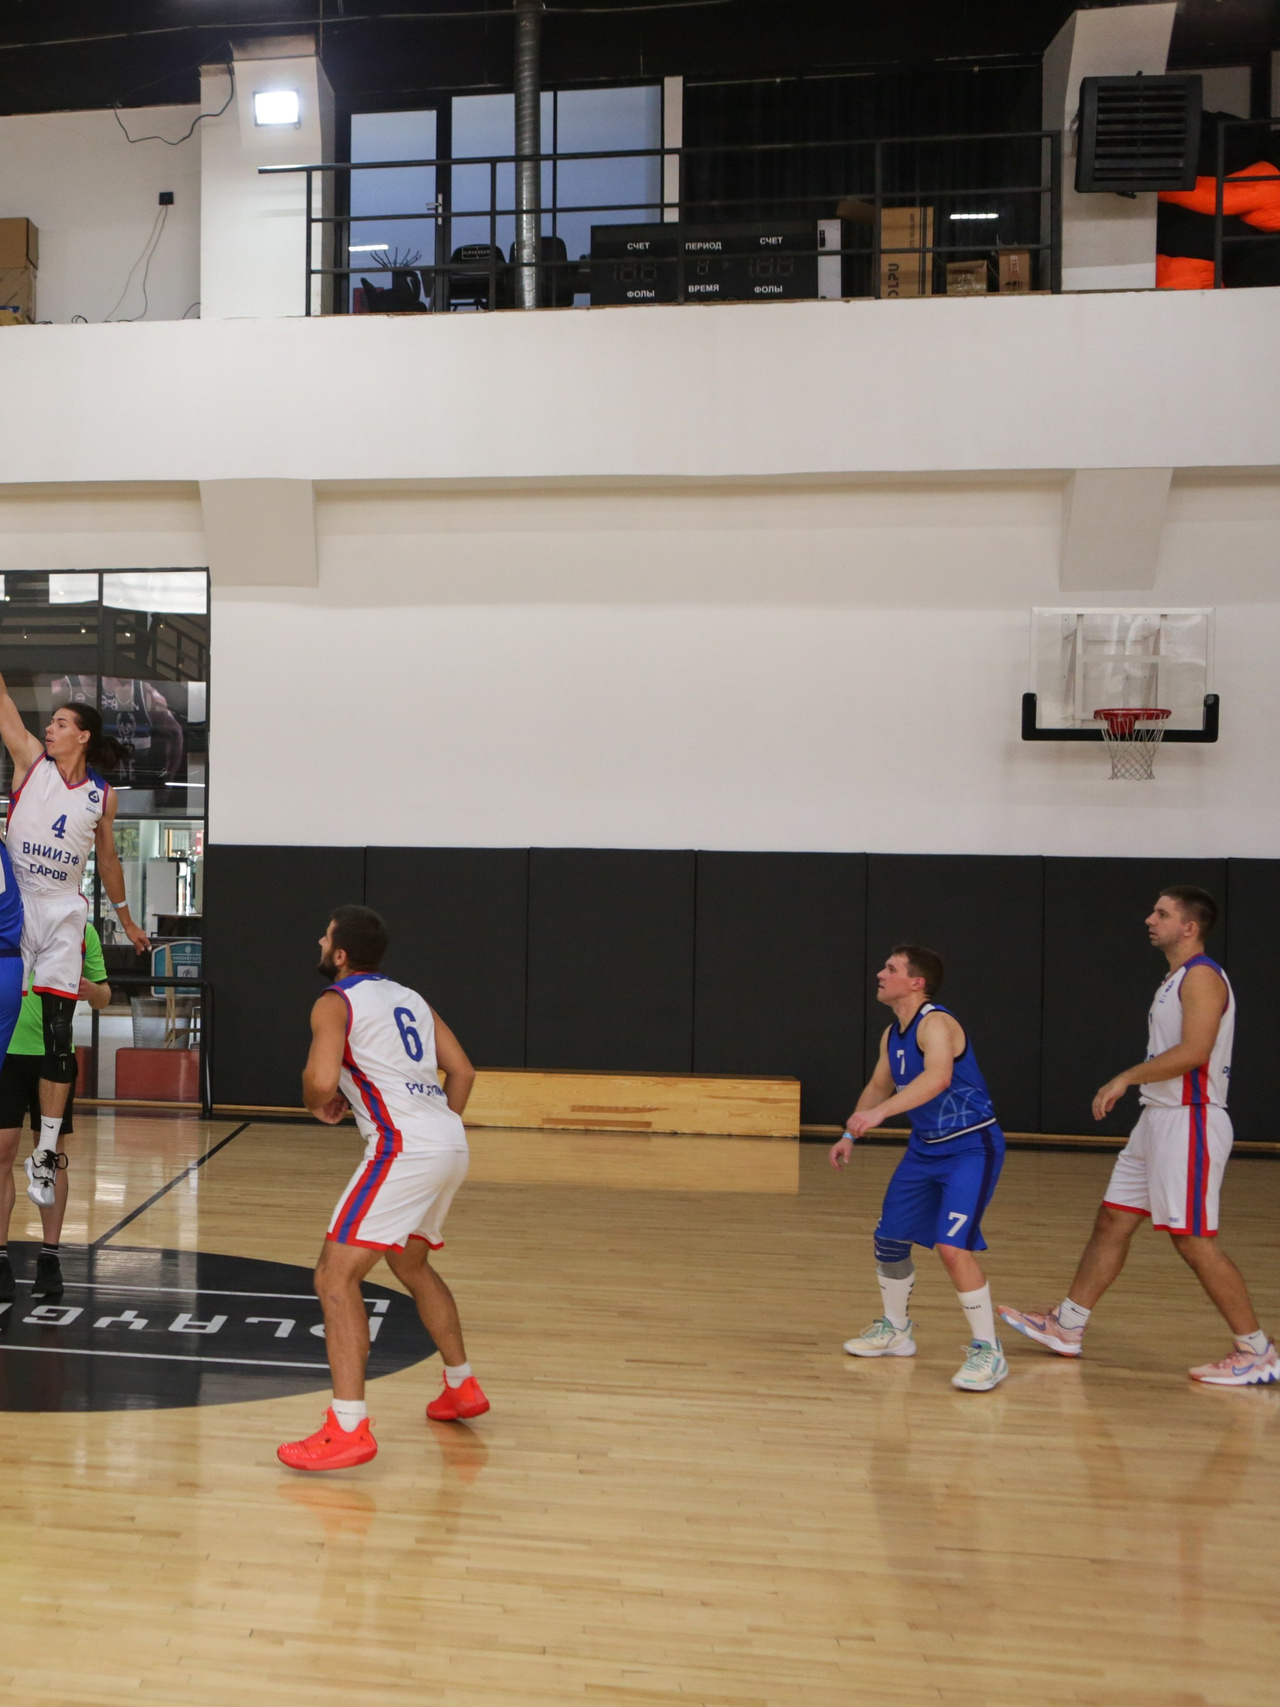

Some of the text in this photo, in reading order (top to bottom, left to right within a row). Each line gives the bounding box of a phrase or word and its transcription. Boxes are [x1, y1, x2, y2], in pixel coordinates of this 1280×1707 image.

[626, 242, 651, 250] СЧЕТ
[685, 241, 722, 250] ПЕРИОД
[759, 236, 784, 245] СЧЕТ
[626, 290, 655, 298] ФОЛЫ
[688, 284, 720, 293] ВРЕМЯ
[754, 285, 783, 294] ФОЛЫ
[51, 814, 68, 839] 4
[22, 841, 80, 866] ВНИИЭФ
[29, 863, 68, 881] САРОВ
[393, 1006, 424, 1063] 6
[896, 1049, 906, 1075] 7
[947, 1211, 968, 1238] 7
